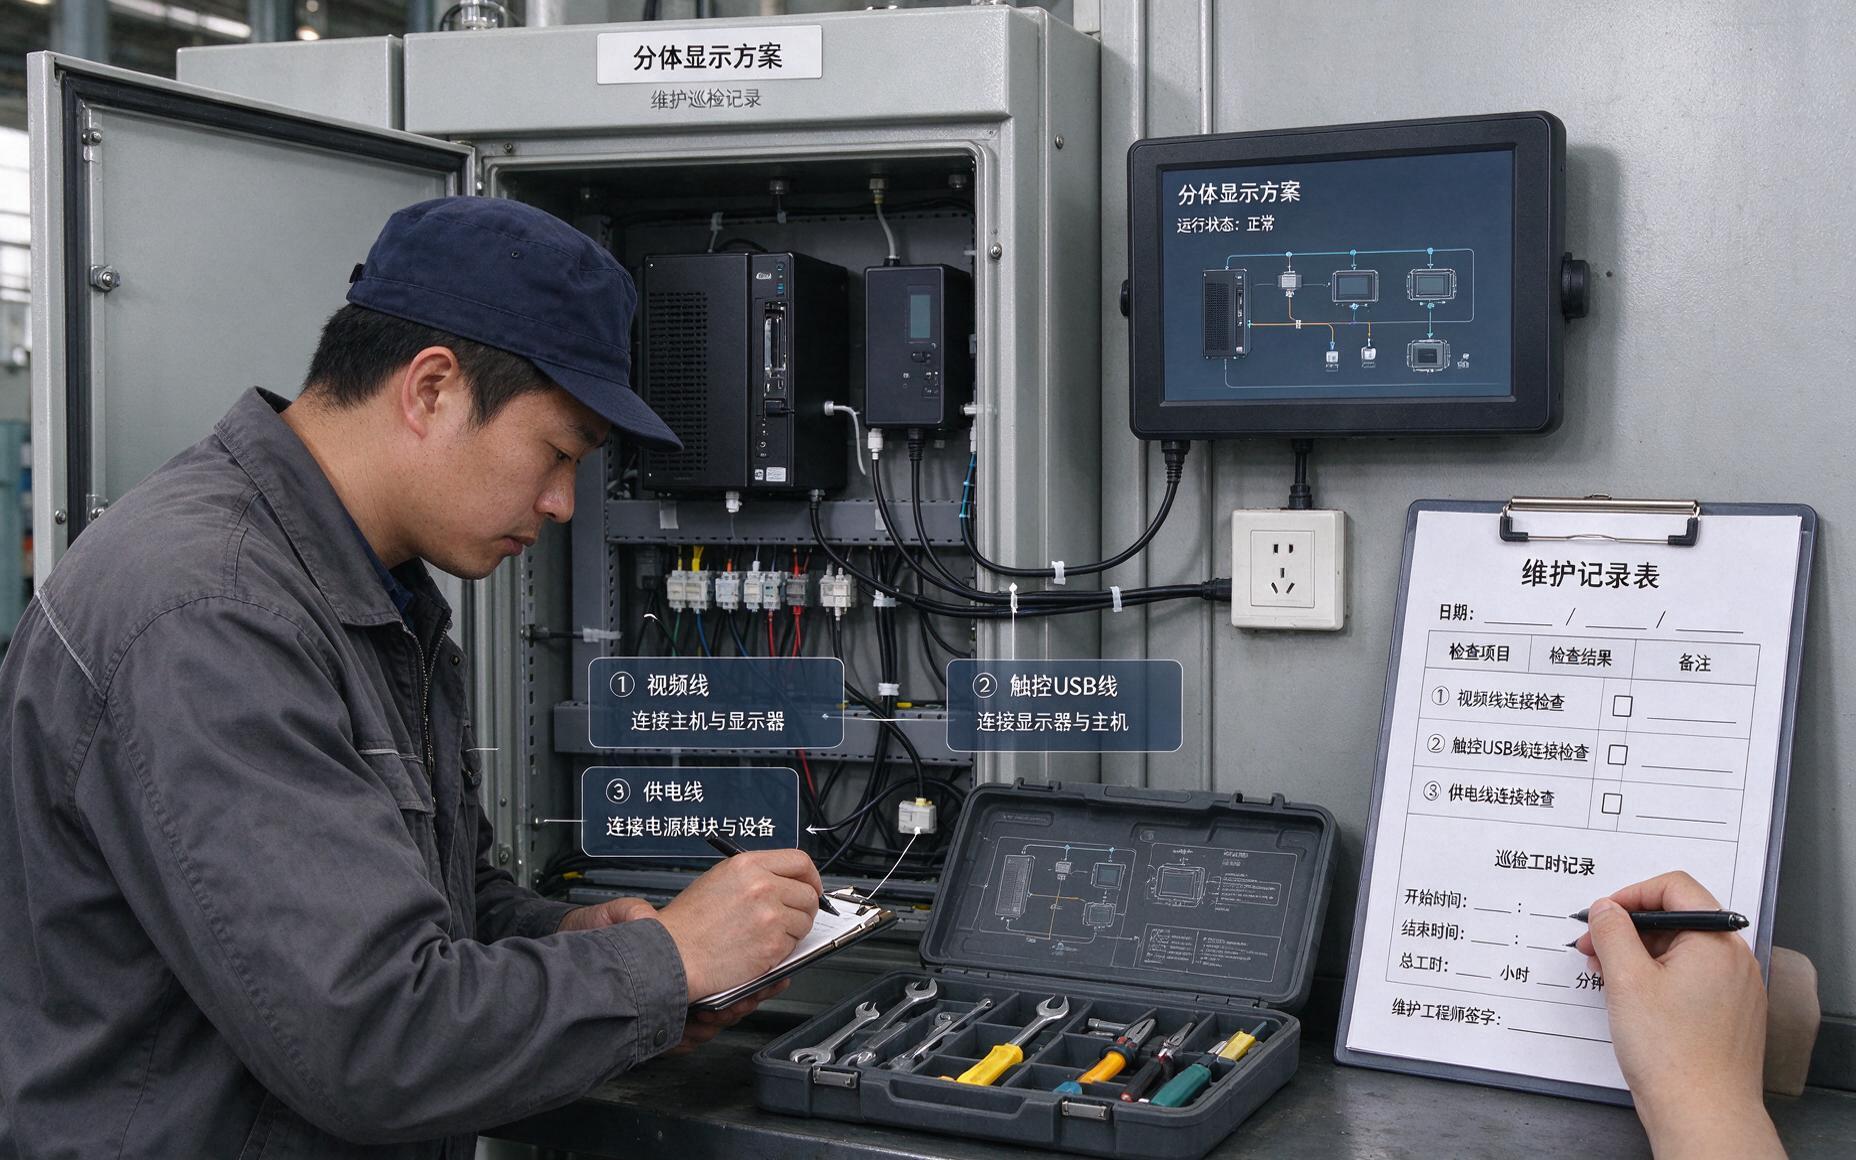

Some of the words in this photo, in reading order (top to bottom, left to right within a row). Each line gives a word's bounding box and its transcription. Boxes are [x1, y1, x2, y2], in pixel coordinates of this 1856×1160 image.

[633, 42, 783, 71] 分体显示方案
[651, 88, 762, 110] 维护巡检记录
[1178, 180, 1301, 206] 分体显示方案
[1521, 558, 1660, 590] 维护记录表
[1449, 642, 1510, 663] 检查项目
[1549, 646, 1613, 667] 检查结果
[1678, 652, 1712, 672] 备注
[1457, 688, 1565, 712] 视频线连接检查
[1451, 736, 1590, 762] 触控USB线连接检查
[1448, 783, 1555, 808] 供电线连接检查
[1494, 849, 1596, 876] 巡检工时记录
[1500, 964, 1530, 983] 小时
